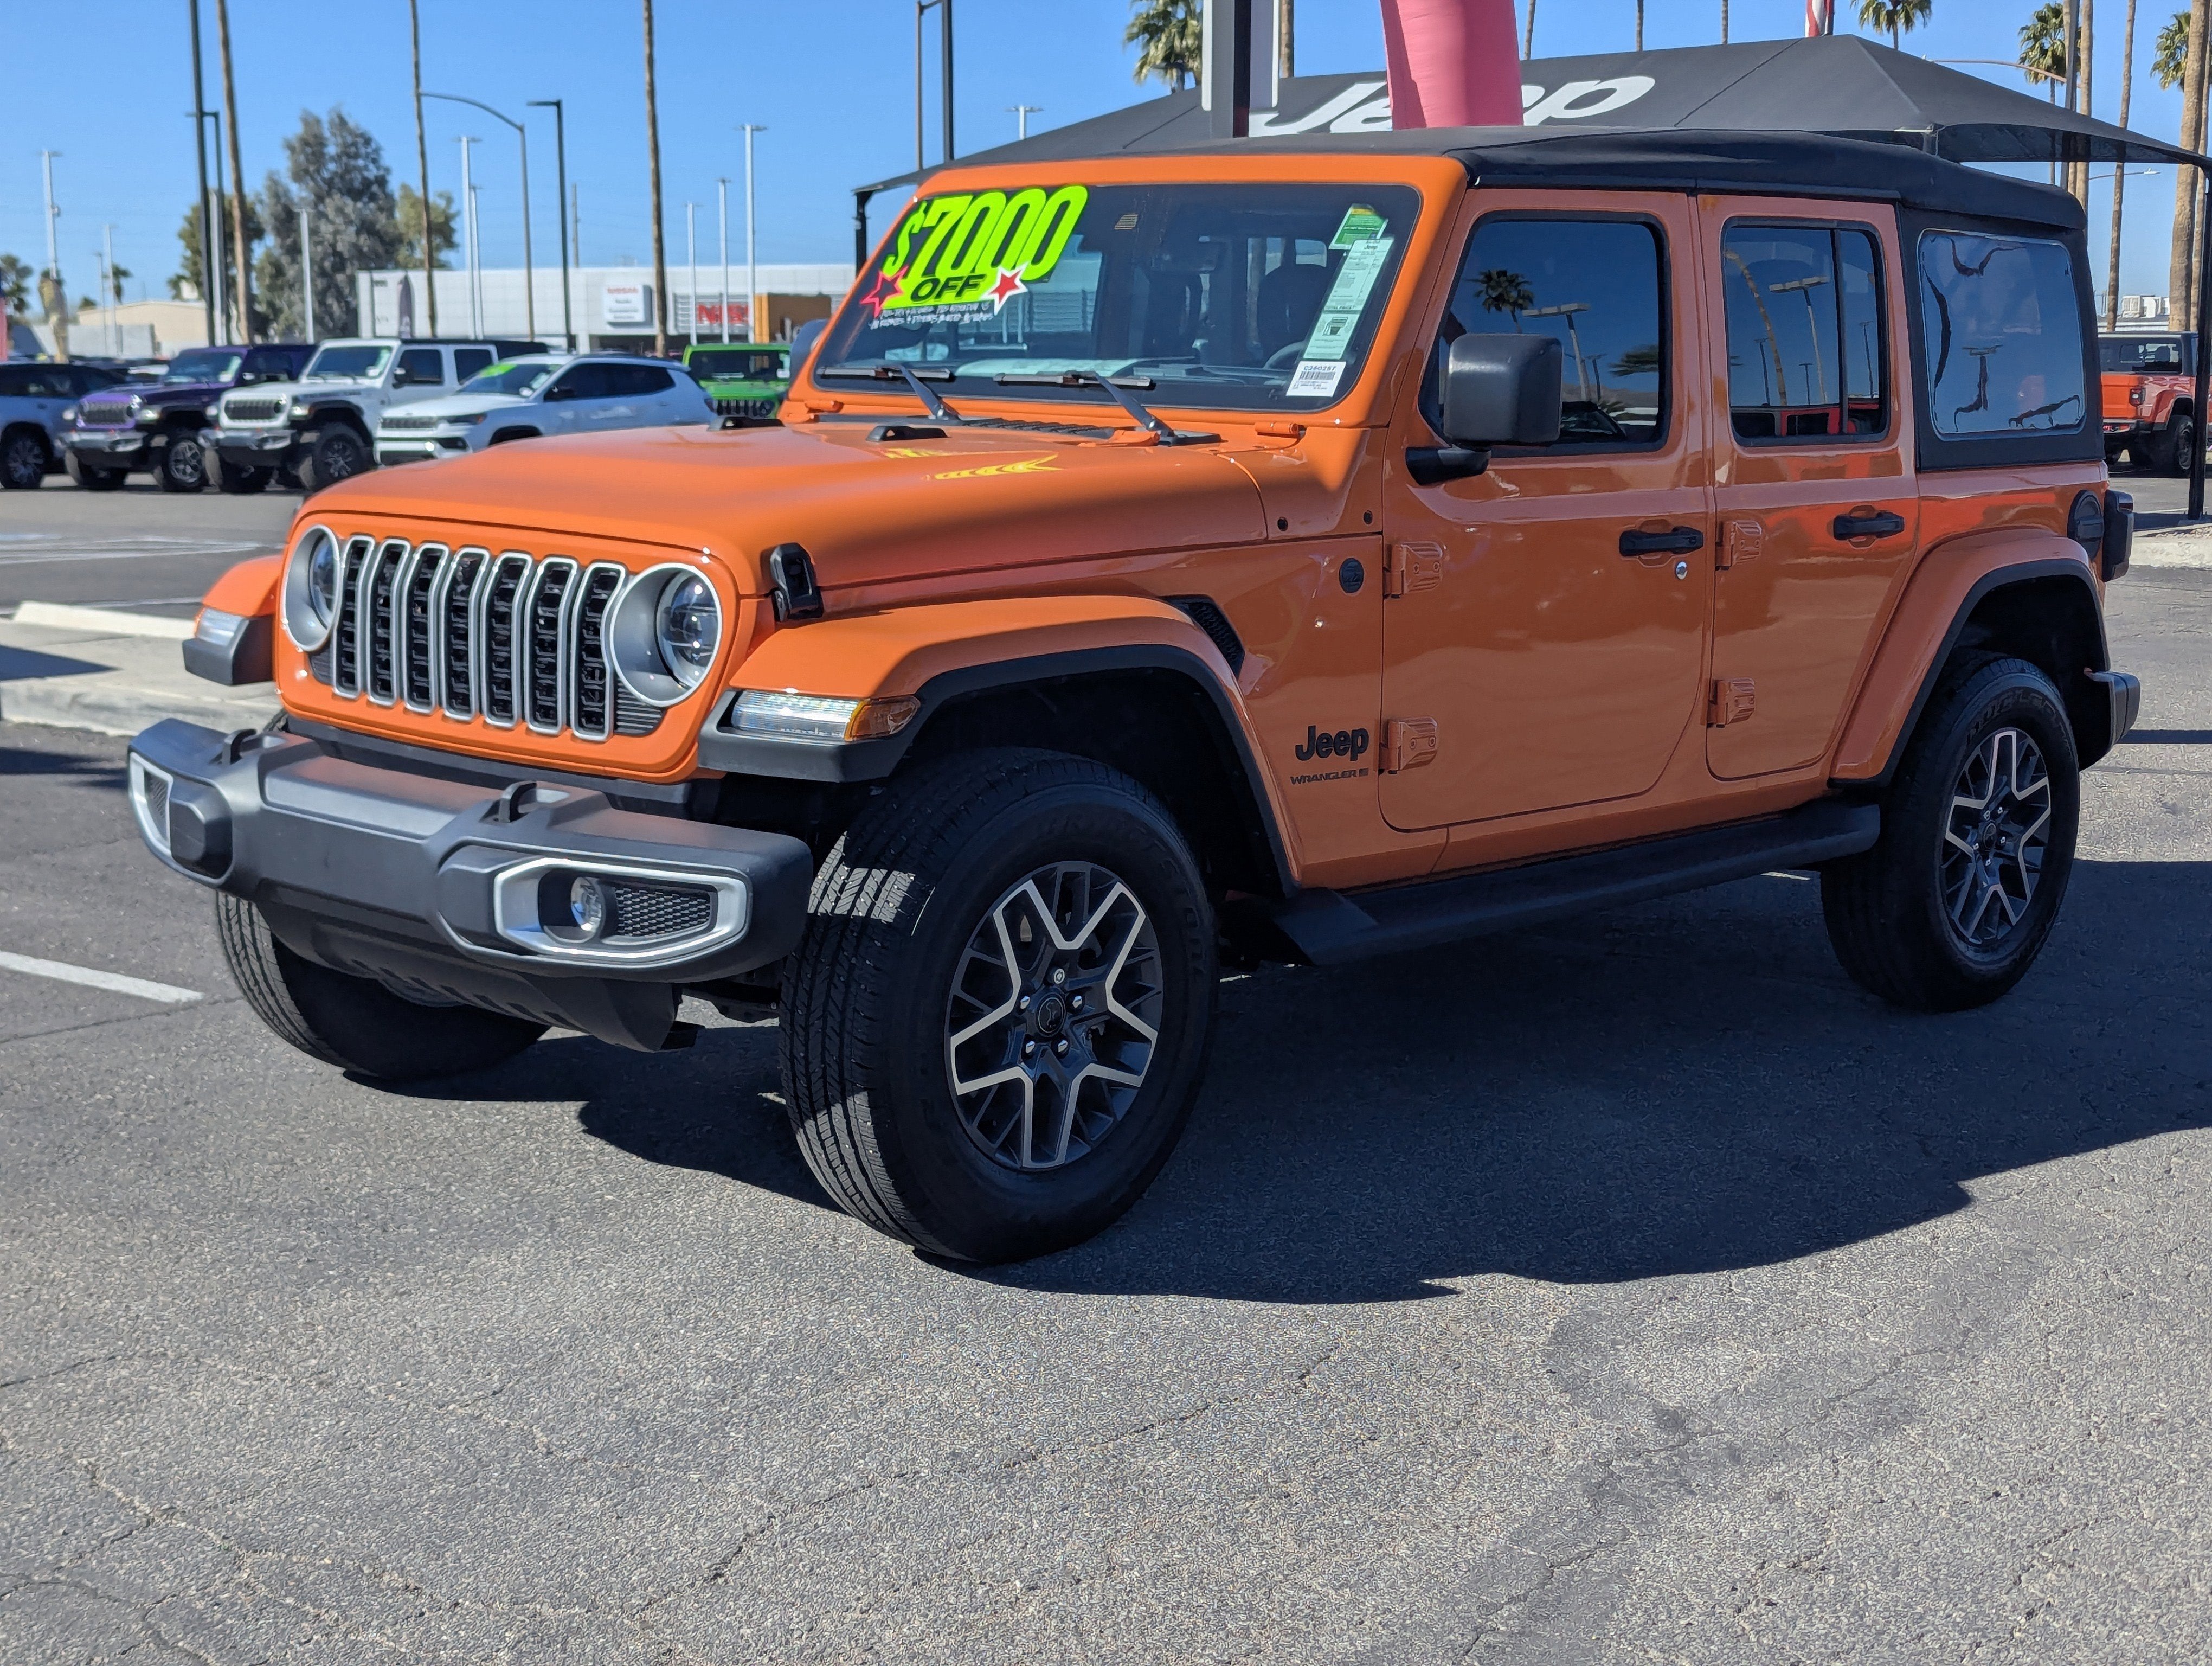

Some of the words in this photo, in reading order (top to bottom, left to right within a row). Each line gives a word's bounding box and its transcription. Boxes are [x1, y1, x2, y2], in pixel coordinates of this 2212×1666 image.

[1249, 75, 1656, 138] Jep
[882, 184, 1088, 280] $7000
[910, 273, 987, 303] OFF
[1295, 725, 1369, 761] Jeep
[1290, 770, 1358, 785] WRANGLER
